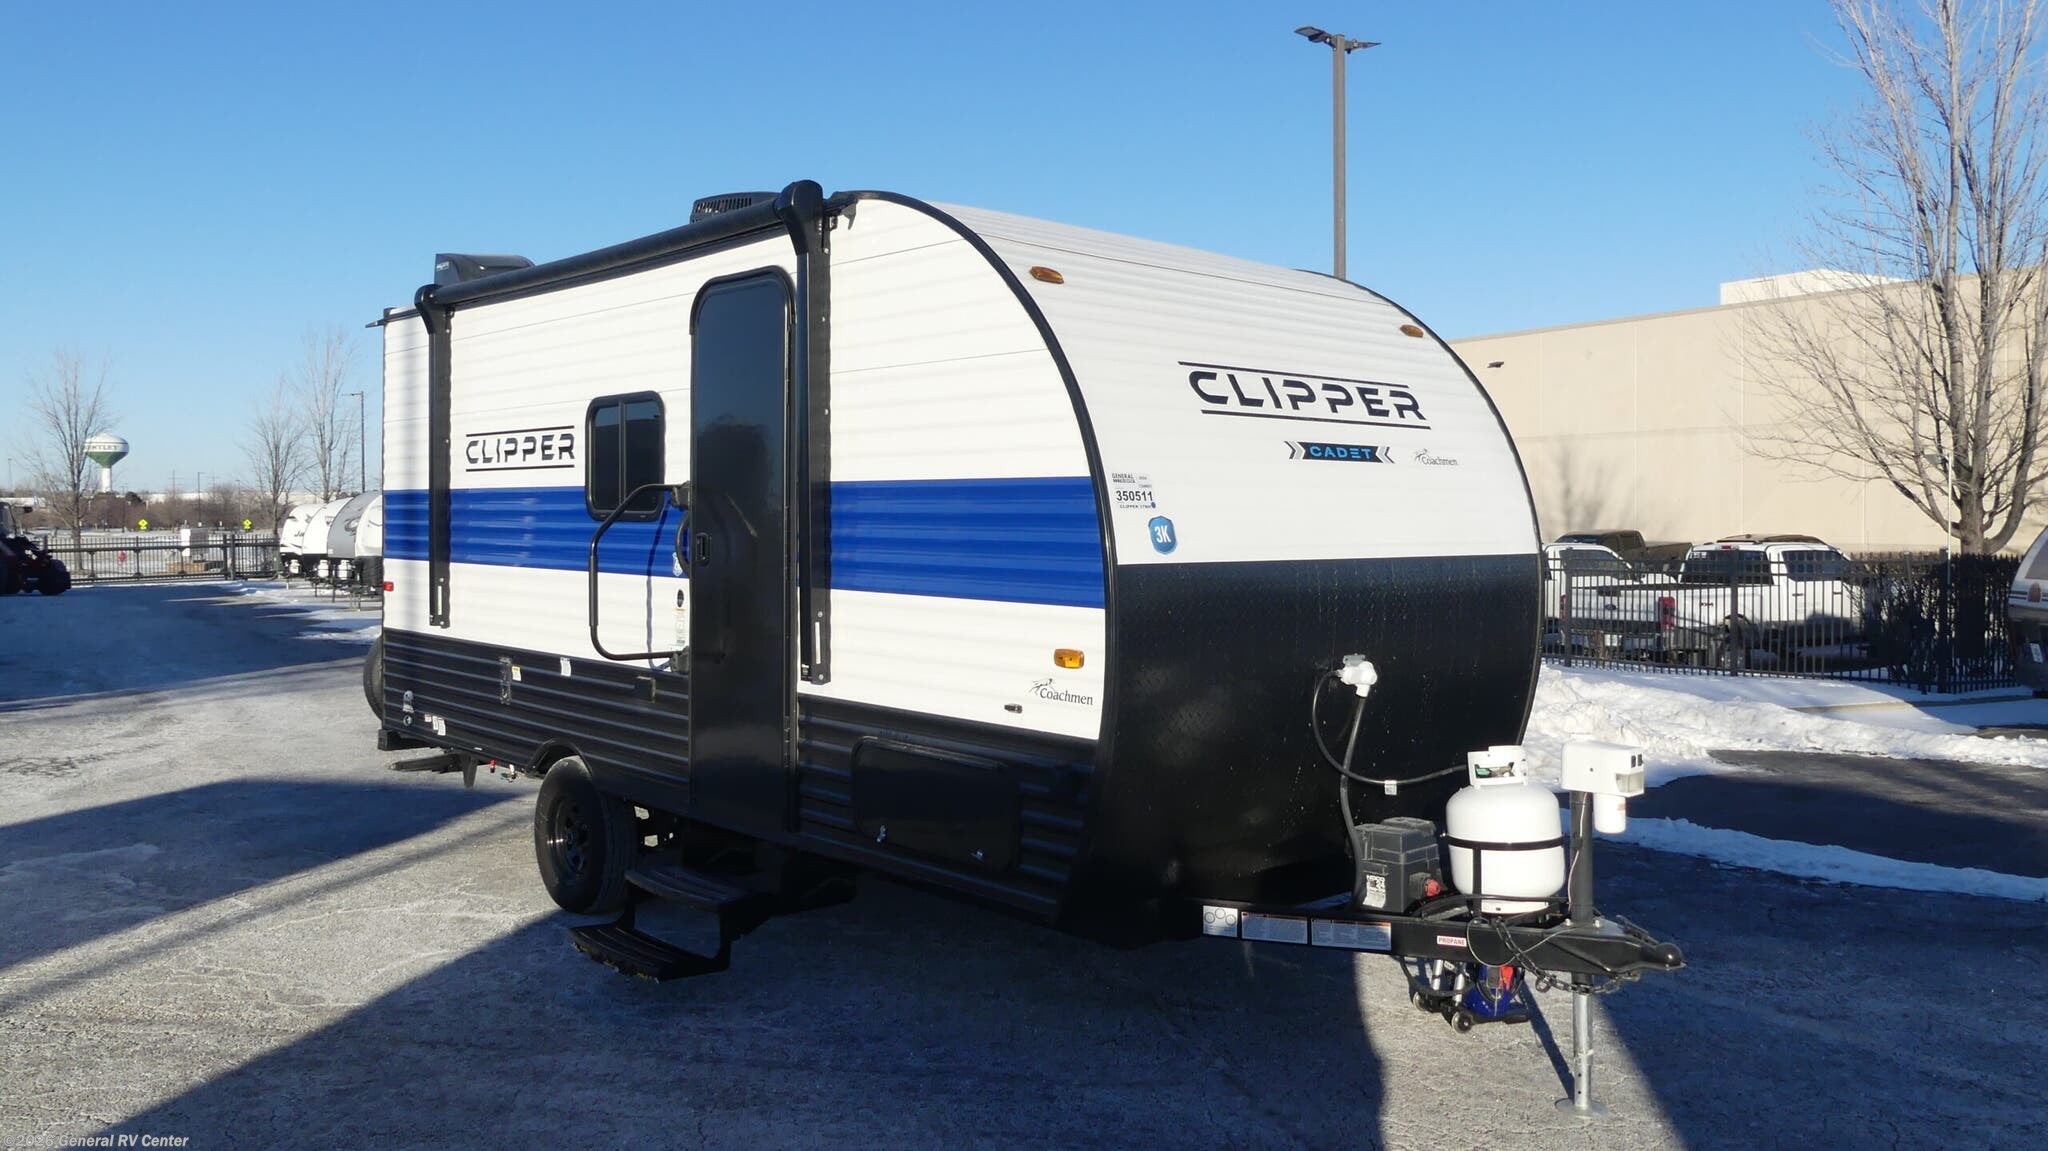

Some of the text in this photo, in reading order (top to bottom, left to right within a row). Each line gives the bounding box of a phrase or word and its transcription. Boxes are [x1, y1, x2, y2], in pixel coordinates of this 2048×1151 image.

[1188, 369, 1427, 421] CLIPPER
[465, 432, 576, 464] CLIPPER
[1308, 445, 1372, 459] CADET
[1421, 454, 1458, 466] Coachmen
[1115, 490, 1153, 502] 350511
[1154, 525, 1172, 544] 3K
[1039, 687, 1094, 706] Coachmen
[1438, 936, 1466, 946] PROPANE
